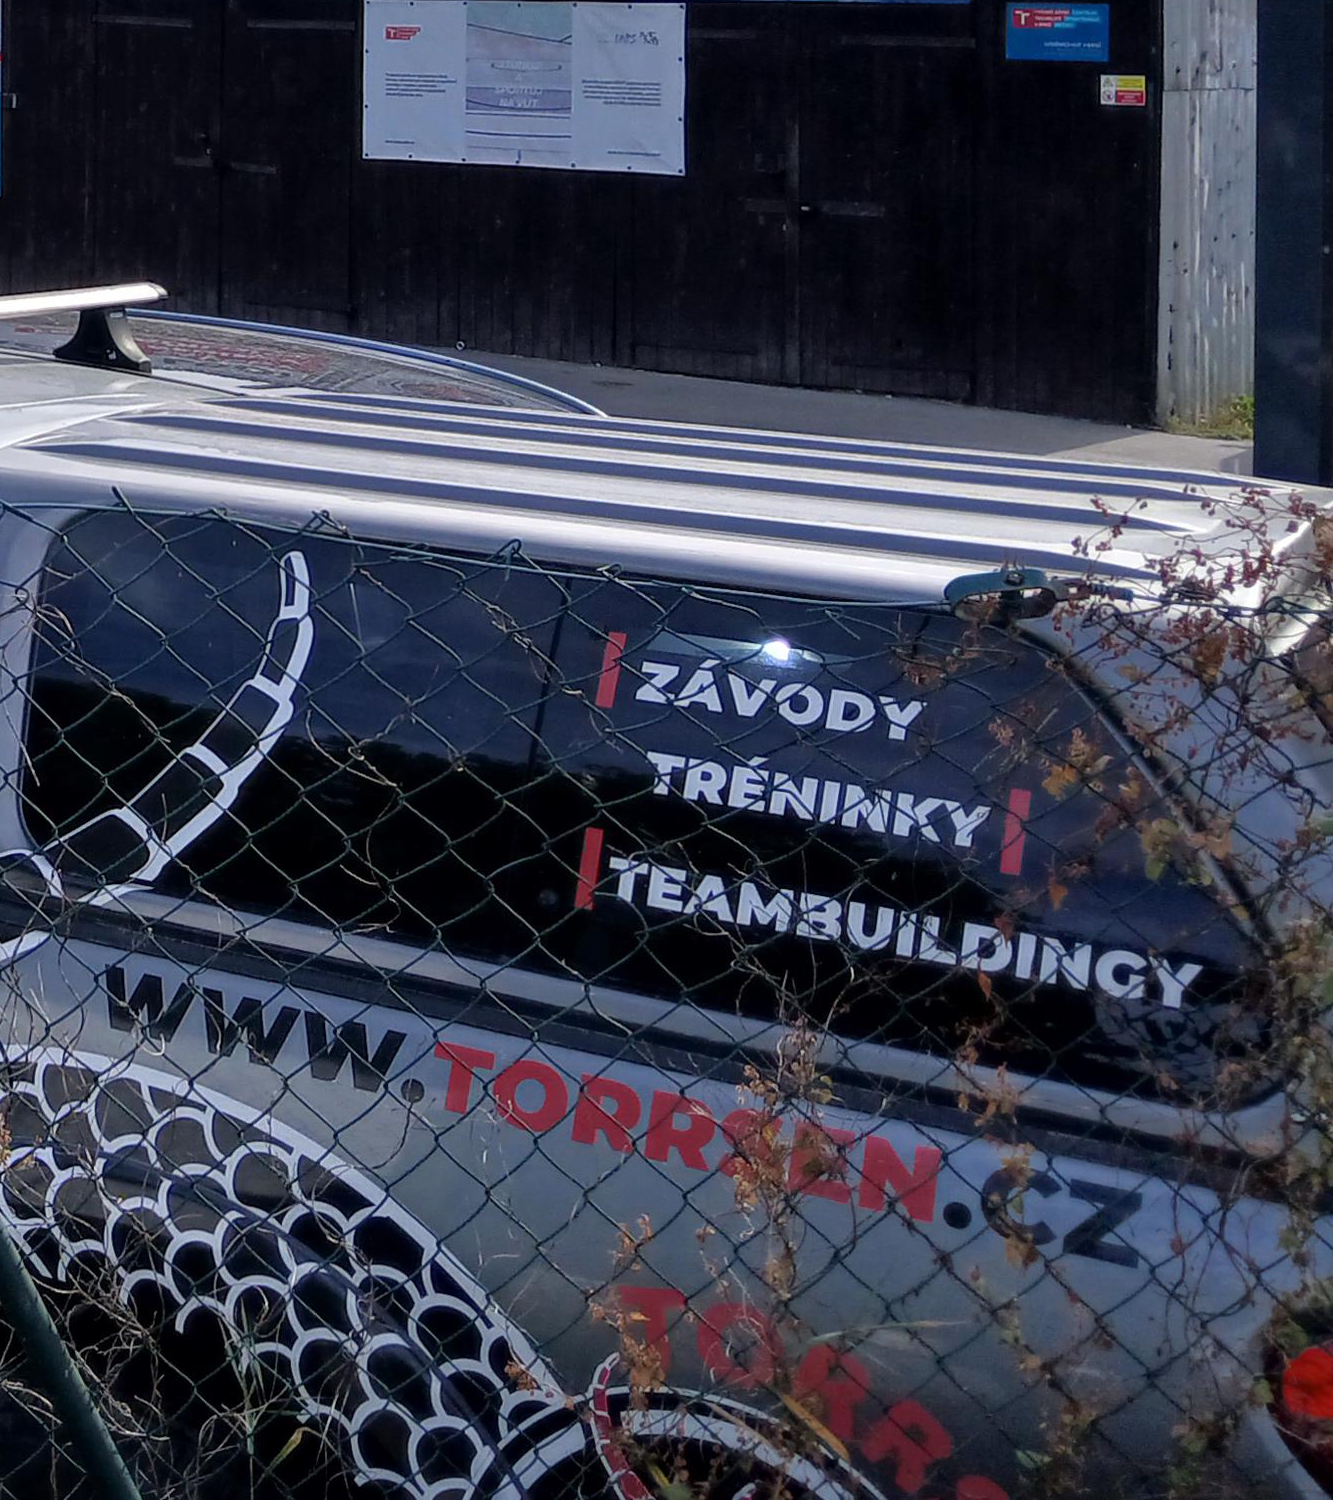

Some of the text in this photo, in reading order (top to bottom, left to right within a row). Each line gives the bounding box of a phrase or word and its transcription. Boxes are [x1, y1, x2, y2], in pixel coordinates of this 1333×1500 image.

[634, 658, 929, 742] ZÁVODY
[645, 751, 992, 849] TRÉNINKY
[607, 856, 1206, 1011] TEAMBUILDINGY
[619, 1284, 1011, 1500] TORR
